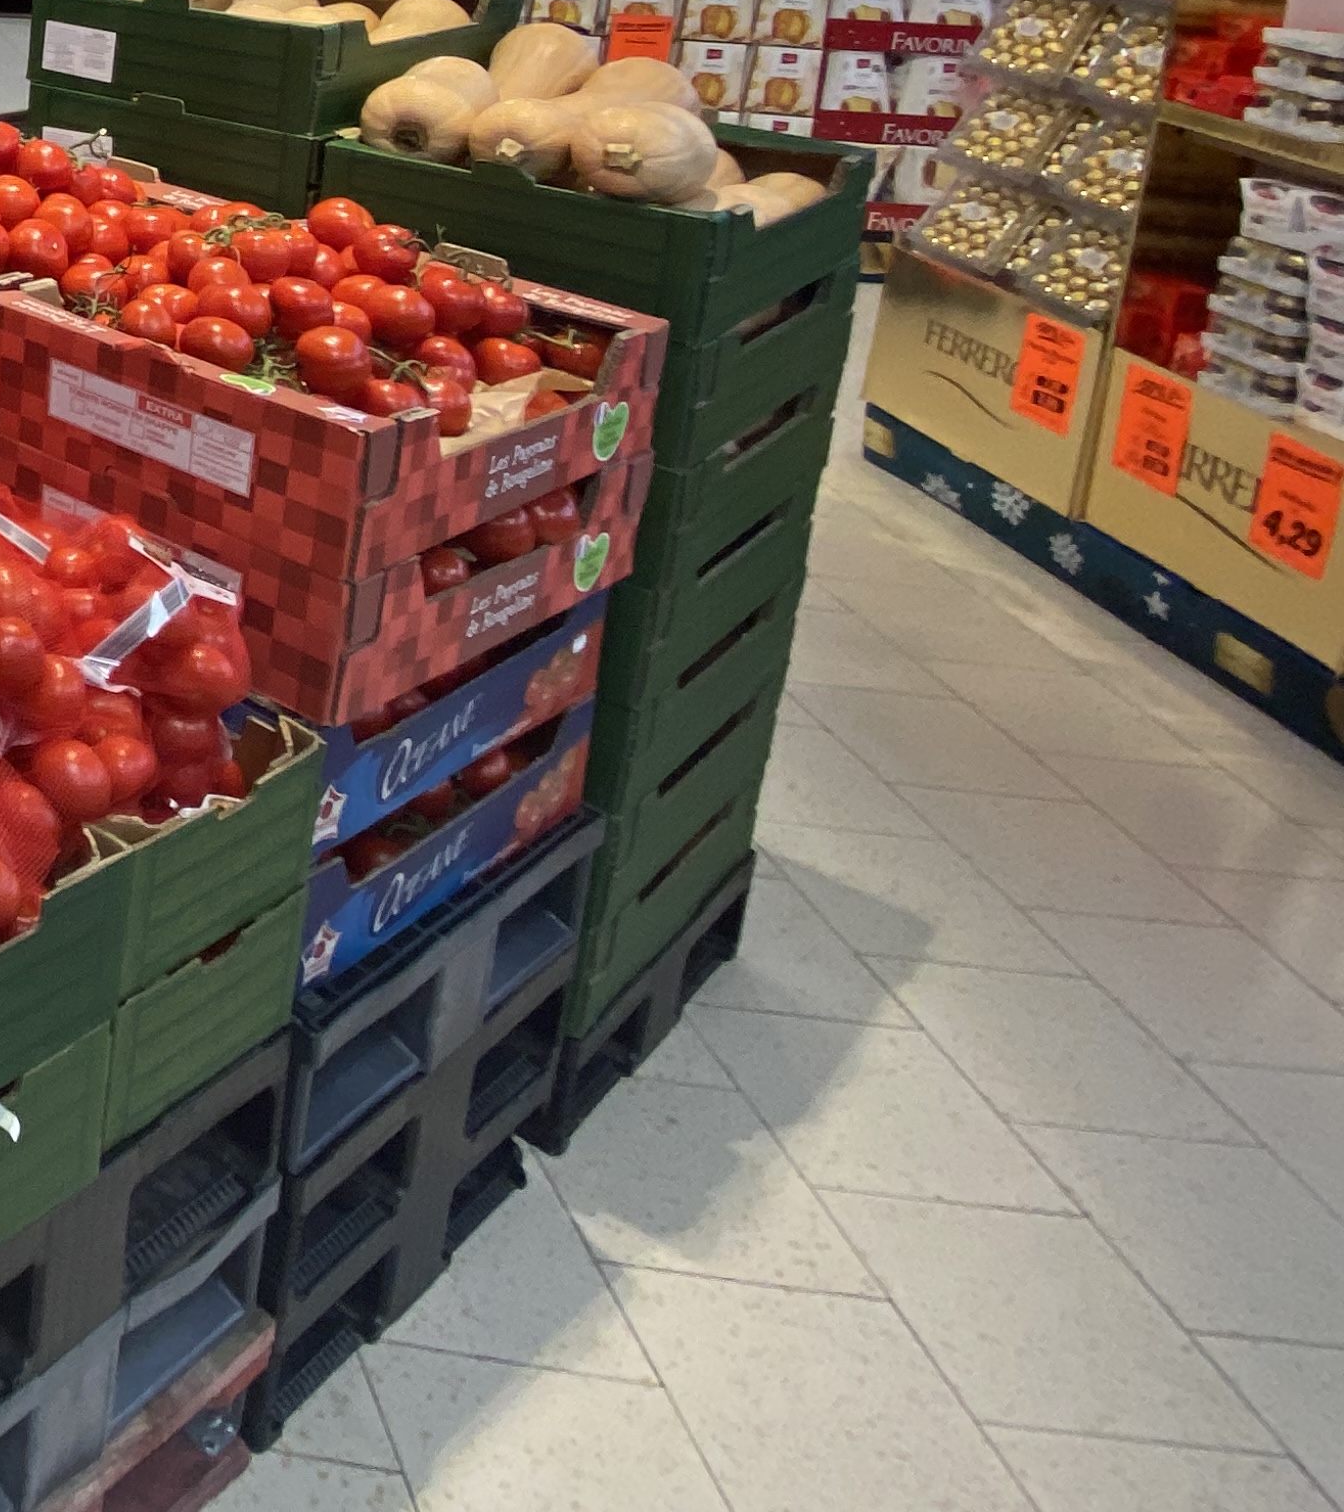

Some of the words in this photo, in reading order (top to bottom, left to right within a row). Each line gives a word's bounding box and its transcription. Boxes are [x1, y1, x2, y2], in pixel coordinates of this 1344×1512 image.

[891, 31, 976, 56] FAVORIN
[881, 123, 949, 144] FAVOR
[924, 318, 1019, 387] FERRER
[146, 399, 184, 424] EXTRA
[1262, 509, 1323, 557] 4,29
